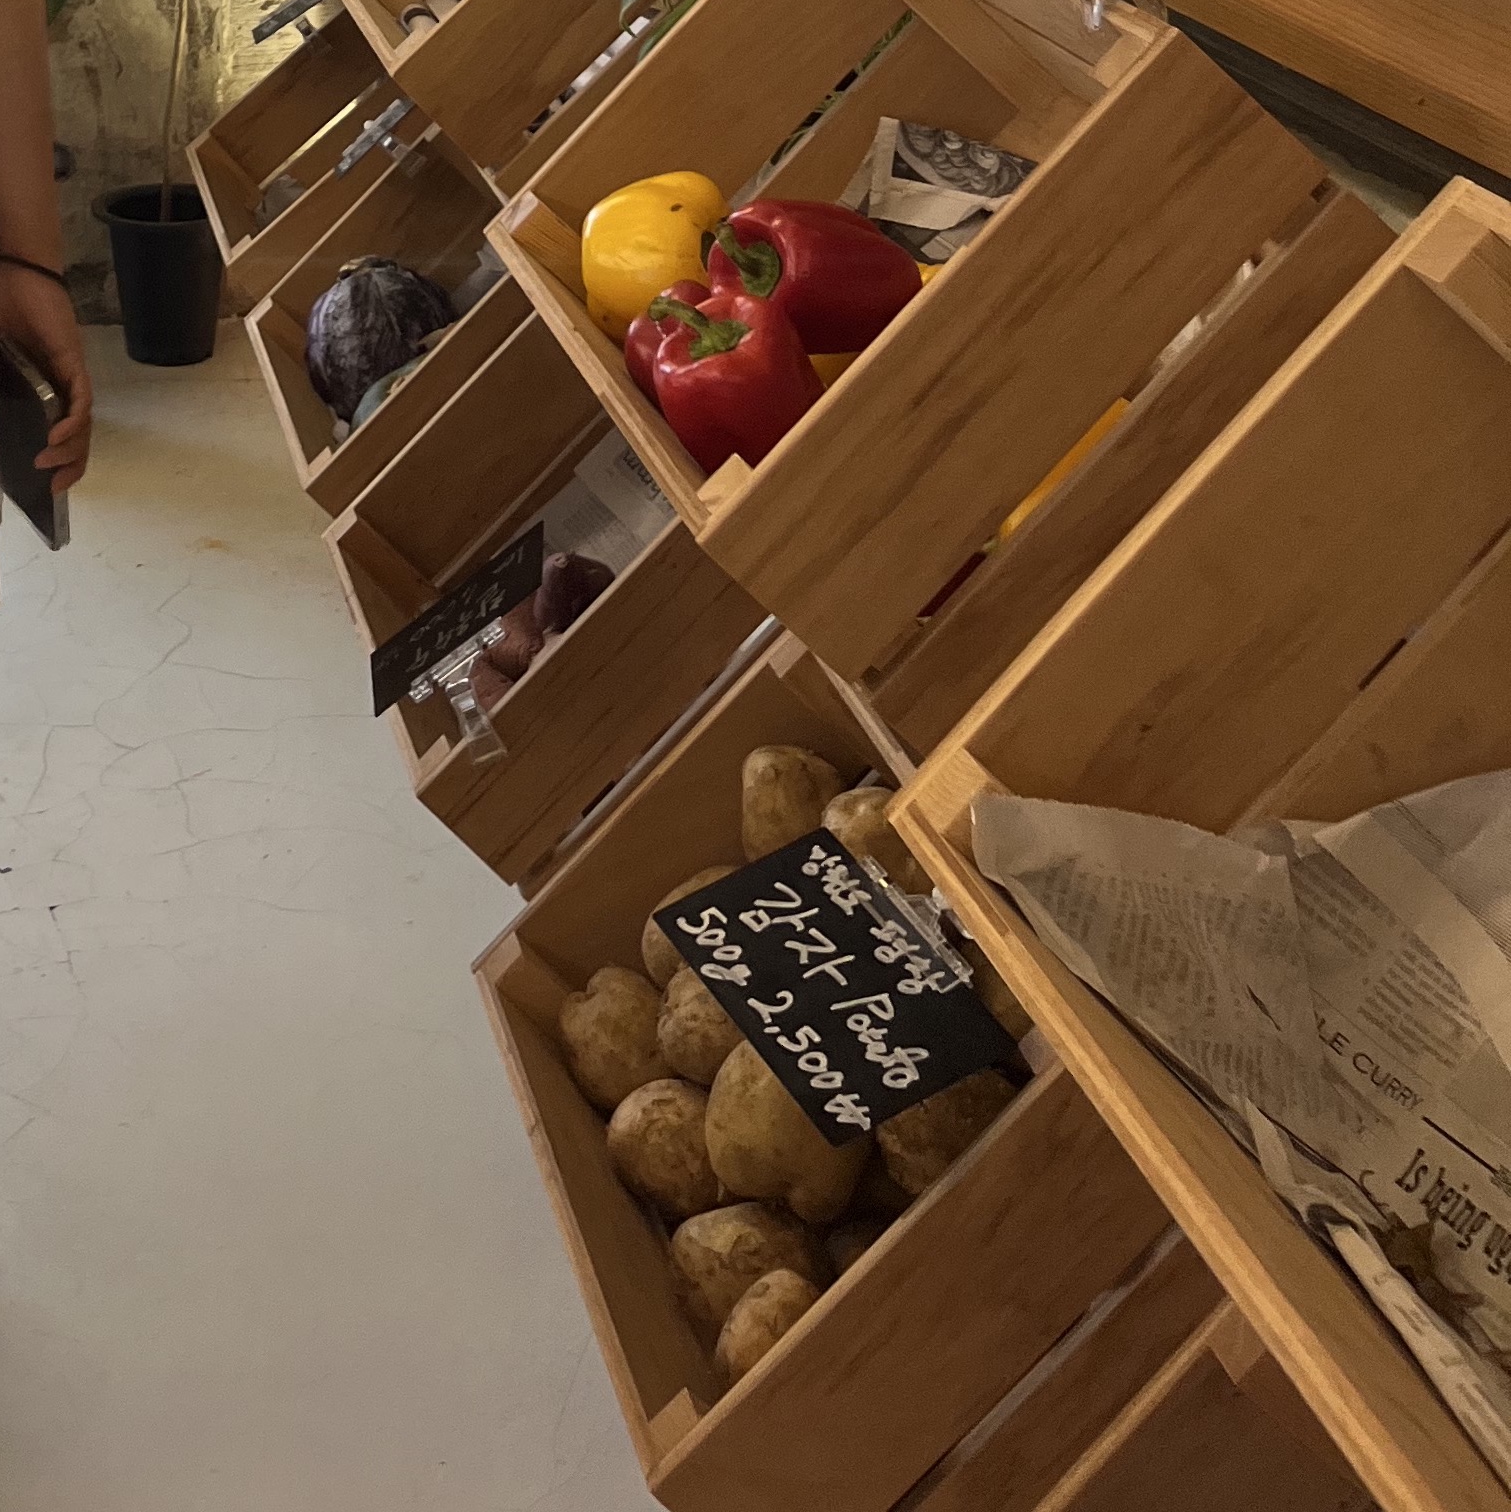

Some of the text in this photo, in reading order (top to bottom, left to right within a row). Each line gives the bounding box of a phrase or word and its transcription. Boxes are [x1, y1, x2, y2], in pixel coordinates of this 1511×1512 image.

[676, 906, 753, 987] 500g
[738, 881, 930, 1089] 감자 Potato
[869, 919, 947, 995] 평창
[1314, 1011, 1425, 1112] LE CURRY
[1394, 1146, 1429, 1194] Is
[1420, 1165, 1493, 1251] being
